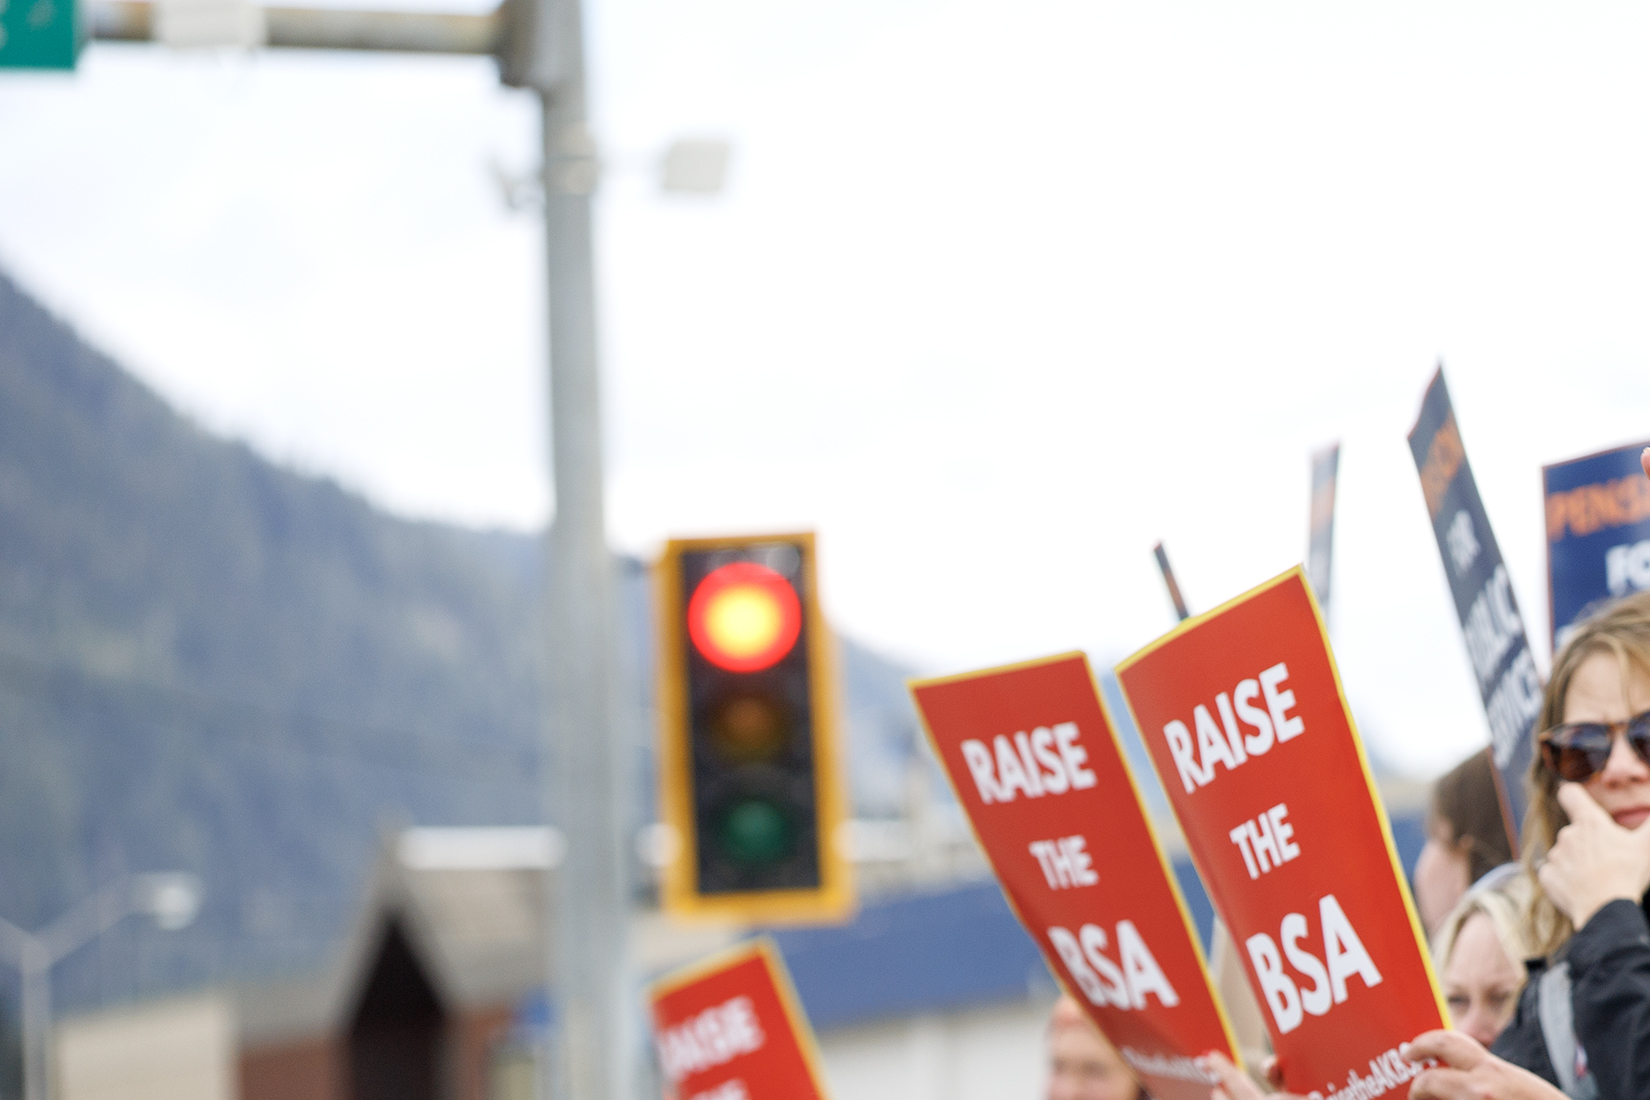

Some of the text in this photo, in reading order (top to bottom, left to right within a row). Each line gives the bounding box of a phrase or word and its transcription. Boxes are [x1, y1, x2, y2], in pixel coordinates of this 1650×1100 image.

[961, 721, 1097, 805] RAISE
[1162, 662, 1305, 795] RAISE
[1030, 835, 1099, 890] THE
[1229, 803, 1301, 881] THE
[1047, 919, 1181, 1012] BSA
[1246, 893, 1384, 1034] BSA
